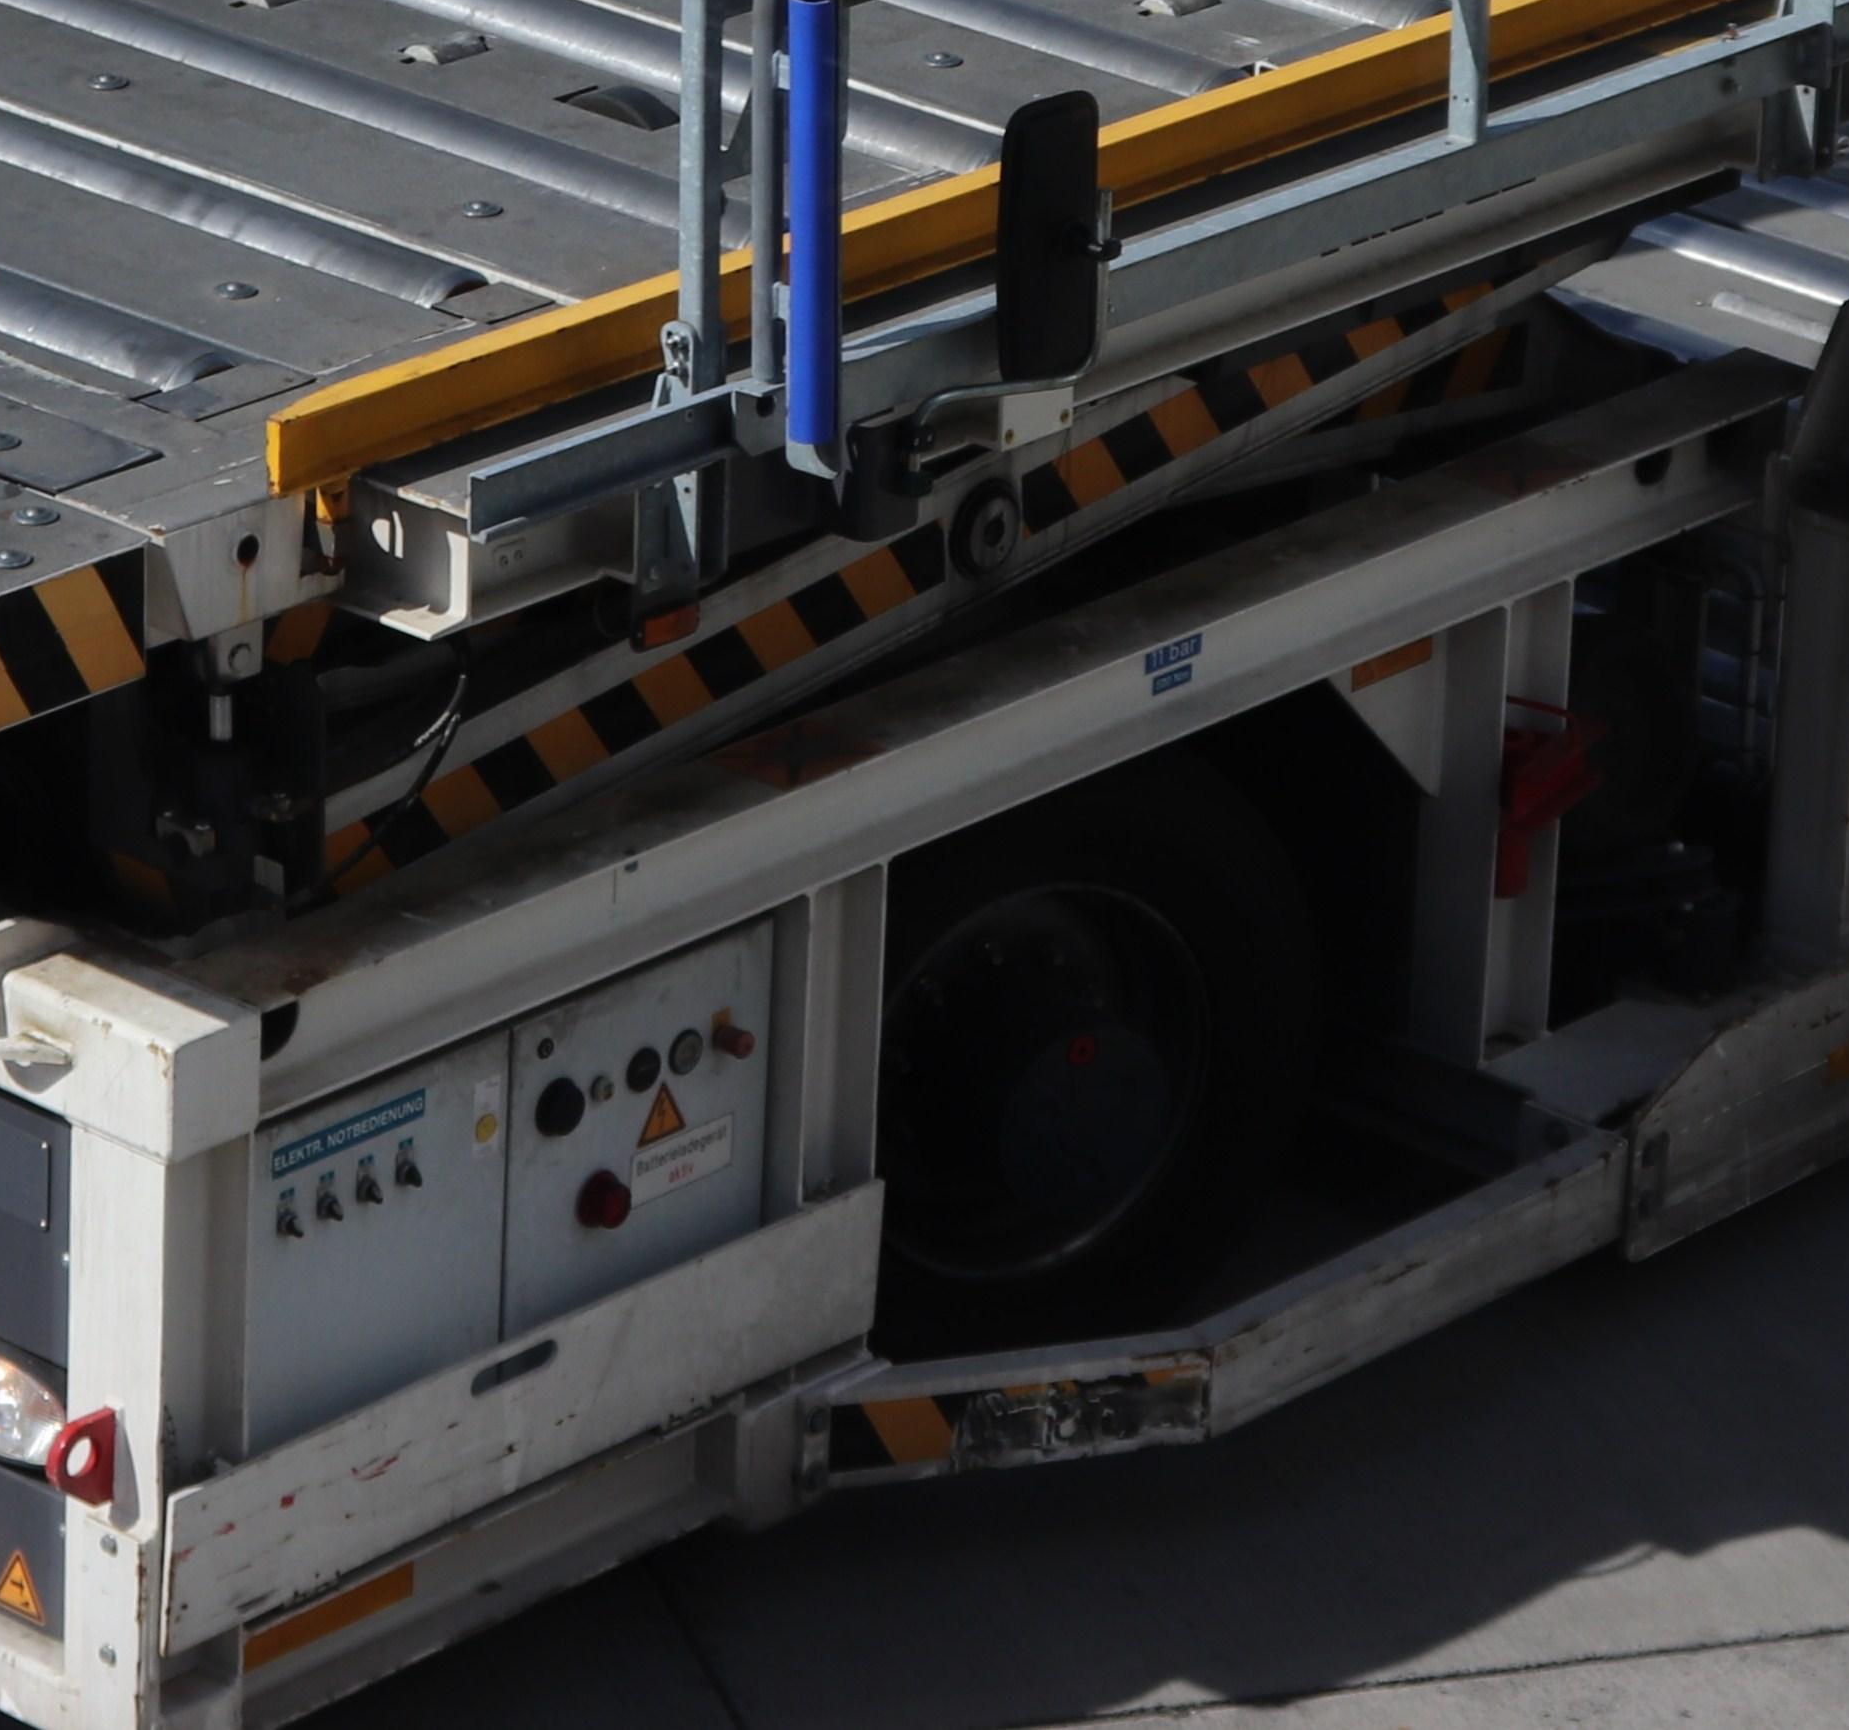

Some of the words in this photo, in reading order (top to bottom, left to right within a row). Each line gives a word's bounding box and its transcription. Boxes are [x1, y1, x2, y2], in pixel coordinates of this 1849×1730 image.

[1170, 637, 1197, 661] bar
[273, 1138, 324, 1170] ELEKTR.
[326, 1096, 424, 1150] NOTBEDIENUNG
[668, 1161, 694, 1183] aktiv
